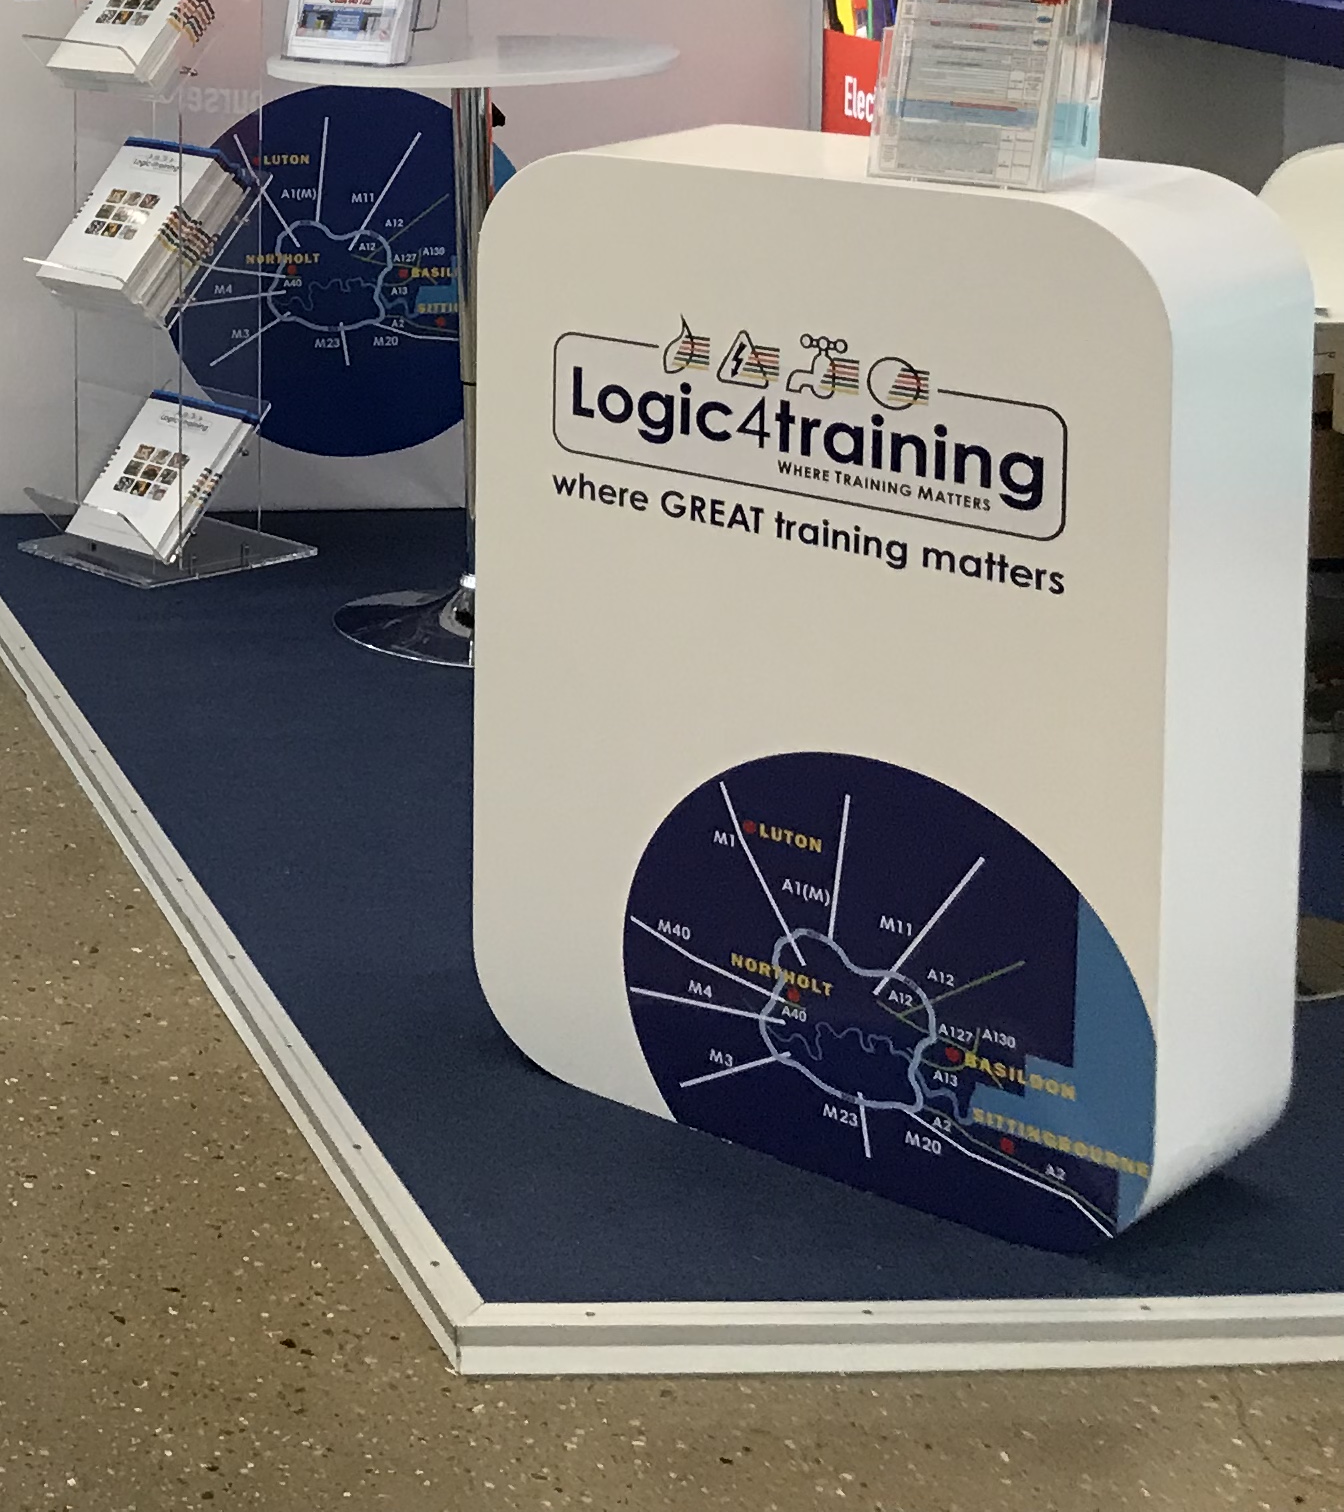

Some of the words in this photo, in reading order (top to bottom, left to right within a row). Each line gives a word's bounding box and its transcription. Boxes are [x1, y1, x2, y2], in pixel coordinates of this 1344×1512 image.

[263, 154, 309, 166] LUTON
[280, 188, 316, 201] A1(M)
[351, 192, 375, 204] M11
[384, 218, 404, 228] A12
[358, 242, 376, 251] A12
[245, 253, 320, 264] NORTHOLT
[411, 267, 458, 279] BASIL
[214, 283, 232, 294] M4
[231, 328, 250, 339] M3
[373, 336, 398, 347] M20
[314, 337, 341, 349] M23
[571, 365, 1044, 511] Logic4training
[777, 458, 830, 484] WHERE
[834, 470, 912, 497] TRAINING
[917, 487, 992, 512] MATTERS
[552, 474, 649, 511] where
[660, 490, 764, 534] GREAT
[774, 510, 908, 569] training
[921, 545, 1065, 595] matters
[713, 830, 735, 847] M1
[759, 823, 822, 853] LUTON
[781, 878, 831, 907] A1(M)
[657, 919, 691, 940] M40
[879, 915, 912, 937] M11
[730, 952, 834, 996] NORTHOLT
[927, 968, 955, 987] A12
[688, 980, 712, 998] M4
[888, 989, 913, 1007] A12
[781, 1005, 807, 1022] A40
[981, 1028, 1016, 1048] A130
[709, 1048, 733, 1067] M3
[932, 1070, 958, 1087] A13
[822, 1103, 858, 1127] M23
[932, 1116, 952, 1132] A2
[904, 1131, 942, 1155] M20
